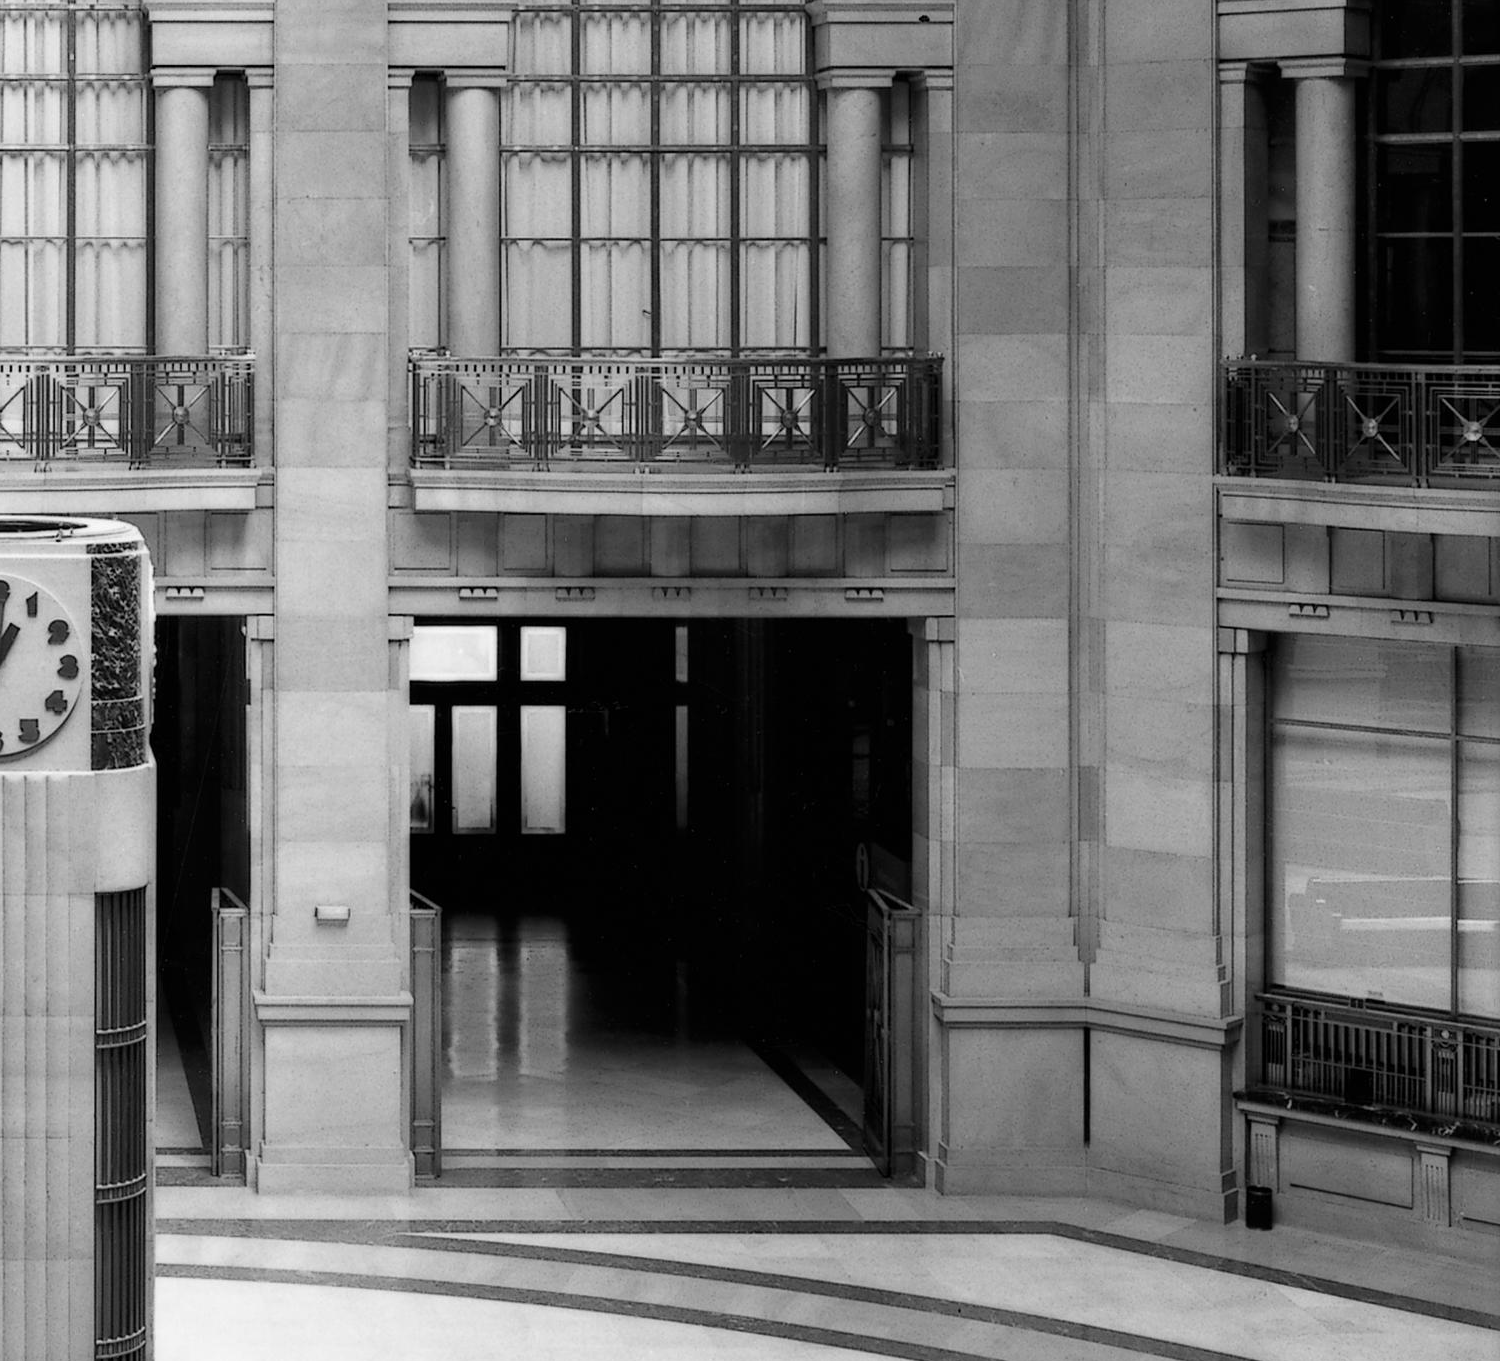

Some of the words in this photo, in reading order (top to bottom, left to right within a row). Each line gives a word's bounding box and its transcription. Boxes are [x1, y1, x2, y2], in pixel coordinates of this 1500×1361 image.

[26, 591, 38, 618] 1
[48, 620, 70, 645] 2
[57, 655, 79, 680] 3
[45, 690, 67, 715] 4
[18, 719, 40, 744] 5
